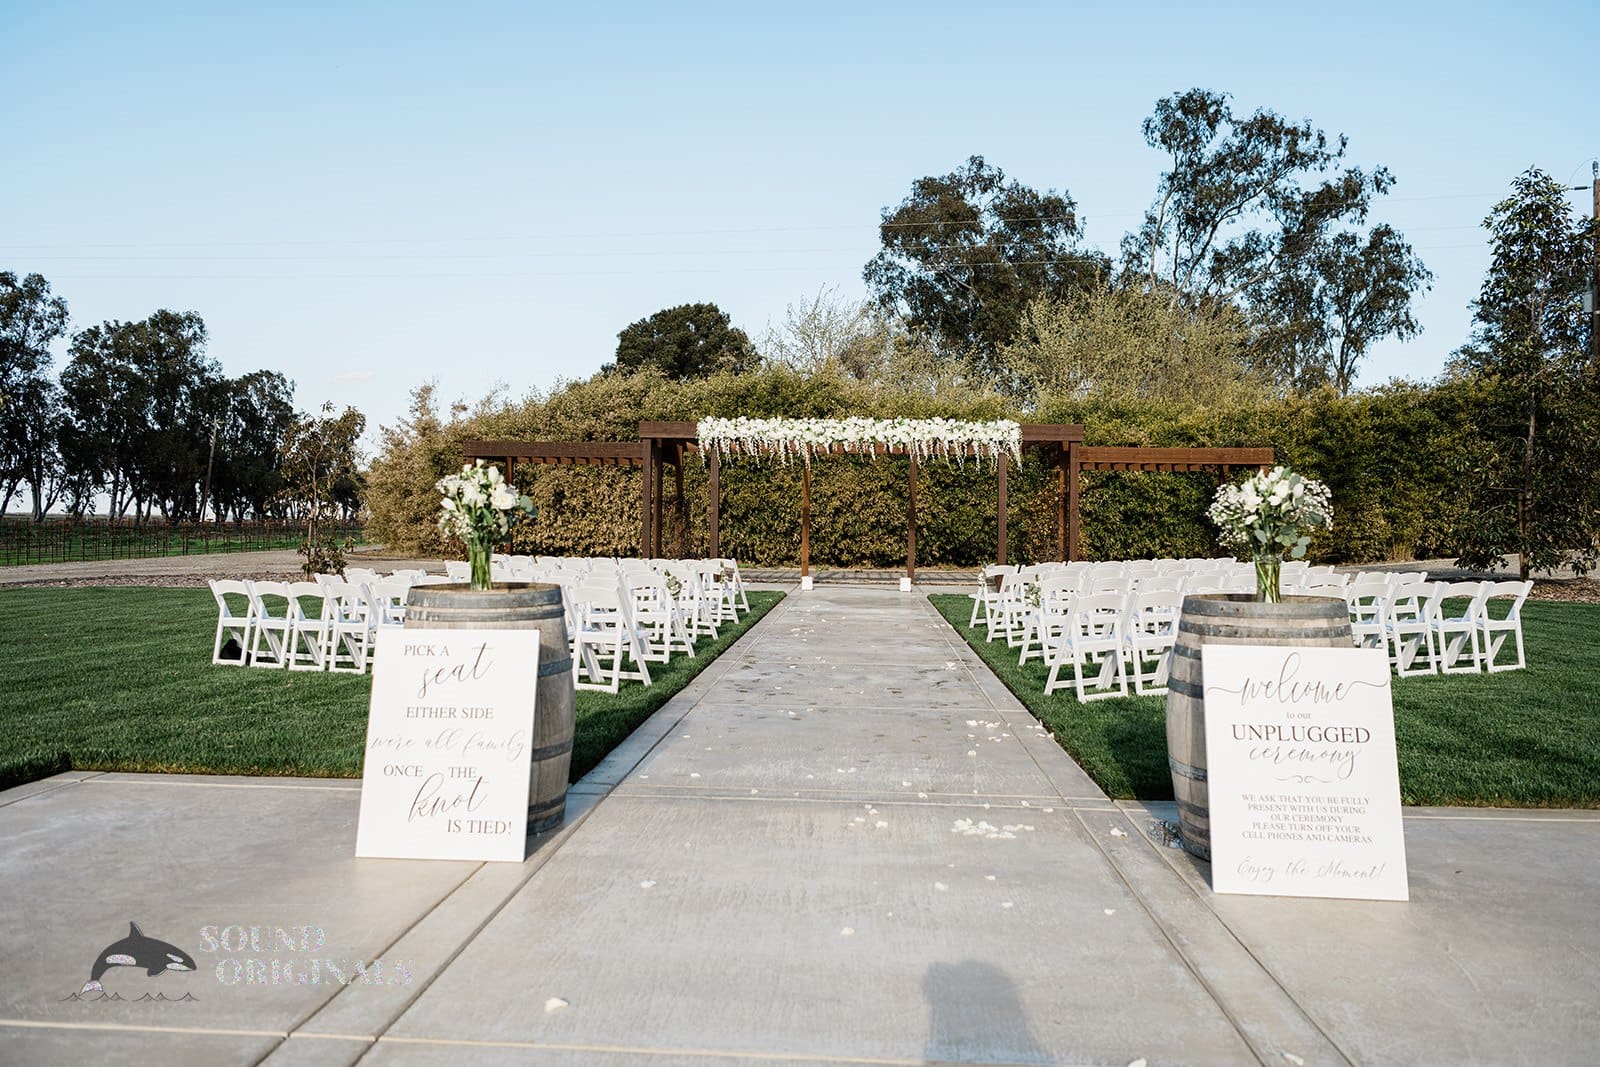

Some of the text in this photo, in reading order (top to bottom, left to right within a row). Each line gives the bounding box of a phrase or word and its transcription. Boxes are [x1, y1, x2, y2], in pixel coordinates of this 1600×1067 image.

[404, 644, 450, 657] PICK A
[417, 642, 495, 699] seat
[1207, 652, 1389, 705] welcome
[406, 707, 494, 719] EITHER SIDE
[1232, 724, 1370, 743] UNPLUGGED
[425, 728, 463, 747] all
[462, 729, 528, 761] family
[1249, 747, 1362, 780] ceremony
[383, 765, 477, 778] ONCE THE
[408, 773, 489, 822] knot
[1242, 794, 1370, 805] WE ASK THAT YOU BE FULLY
[1248, 803, 1366, 815] PRESENT WITH US DURING
[1270, 813, 1343, 824] OUR CEREMONY
[447, 820, 512, 835] IS TIED!
[1252, 822, 1361, 834] PLEASE TURN OFF YOUR
[1242, 831, 1373, 844] CELL PHONES AND CAMERAS
[1237, 856, 1386, 881] Enjoy the Moment!
